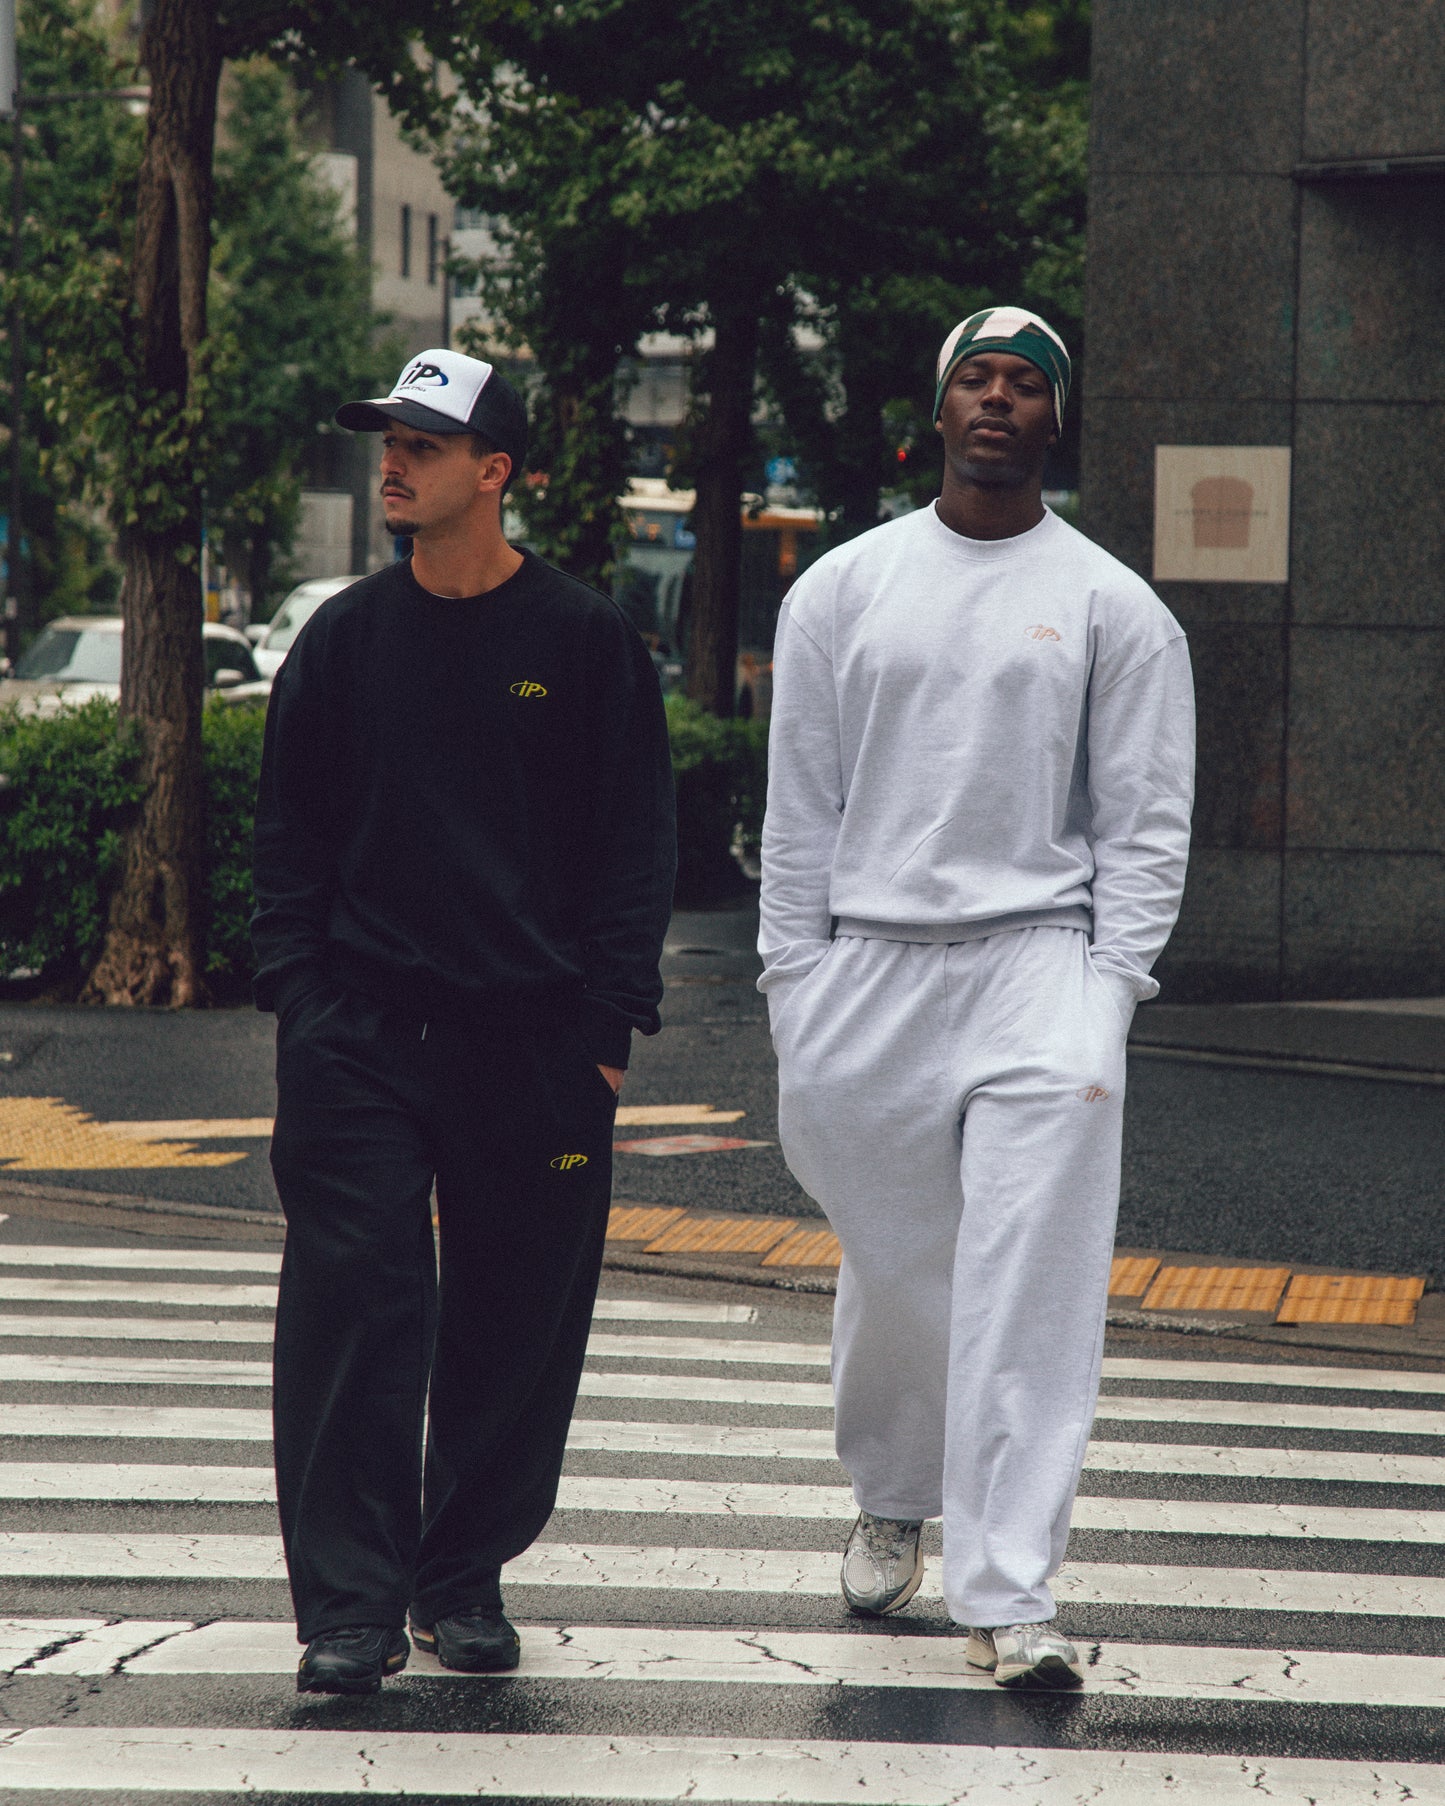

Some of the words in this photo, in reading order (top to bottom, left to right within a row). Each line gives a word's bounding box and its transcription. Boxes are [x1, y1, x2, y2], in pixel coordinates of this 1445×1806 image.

[401, 361, 441, 386] iP
[518, 680, 541, 698] iP
[559, 1153, 582, 1170] iP
